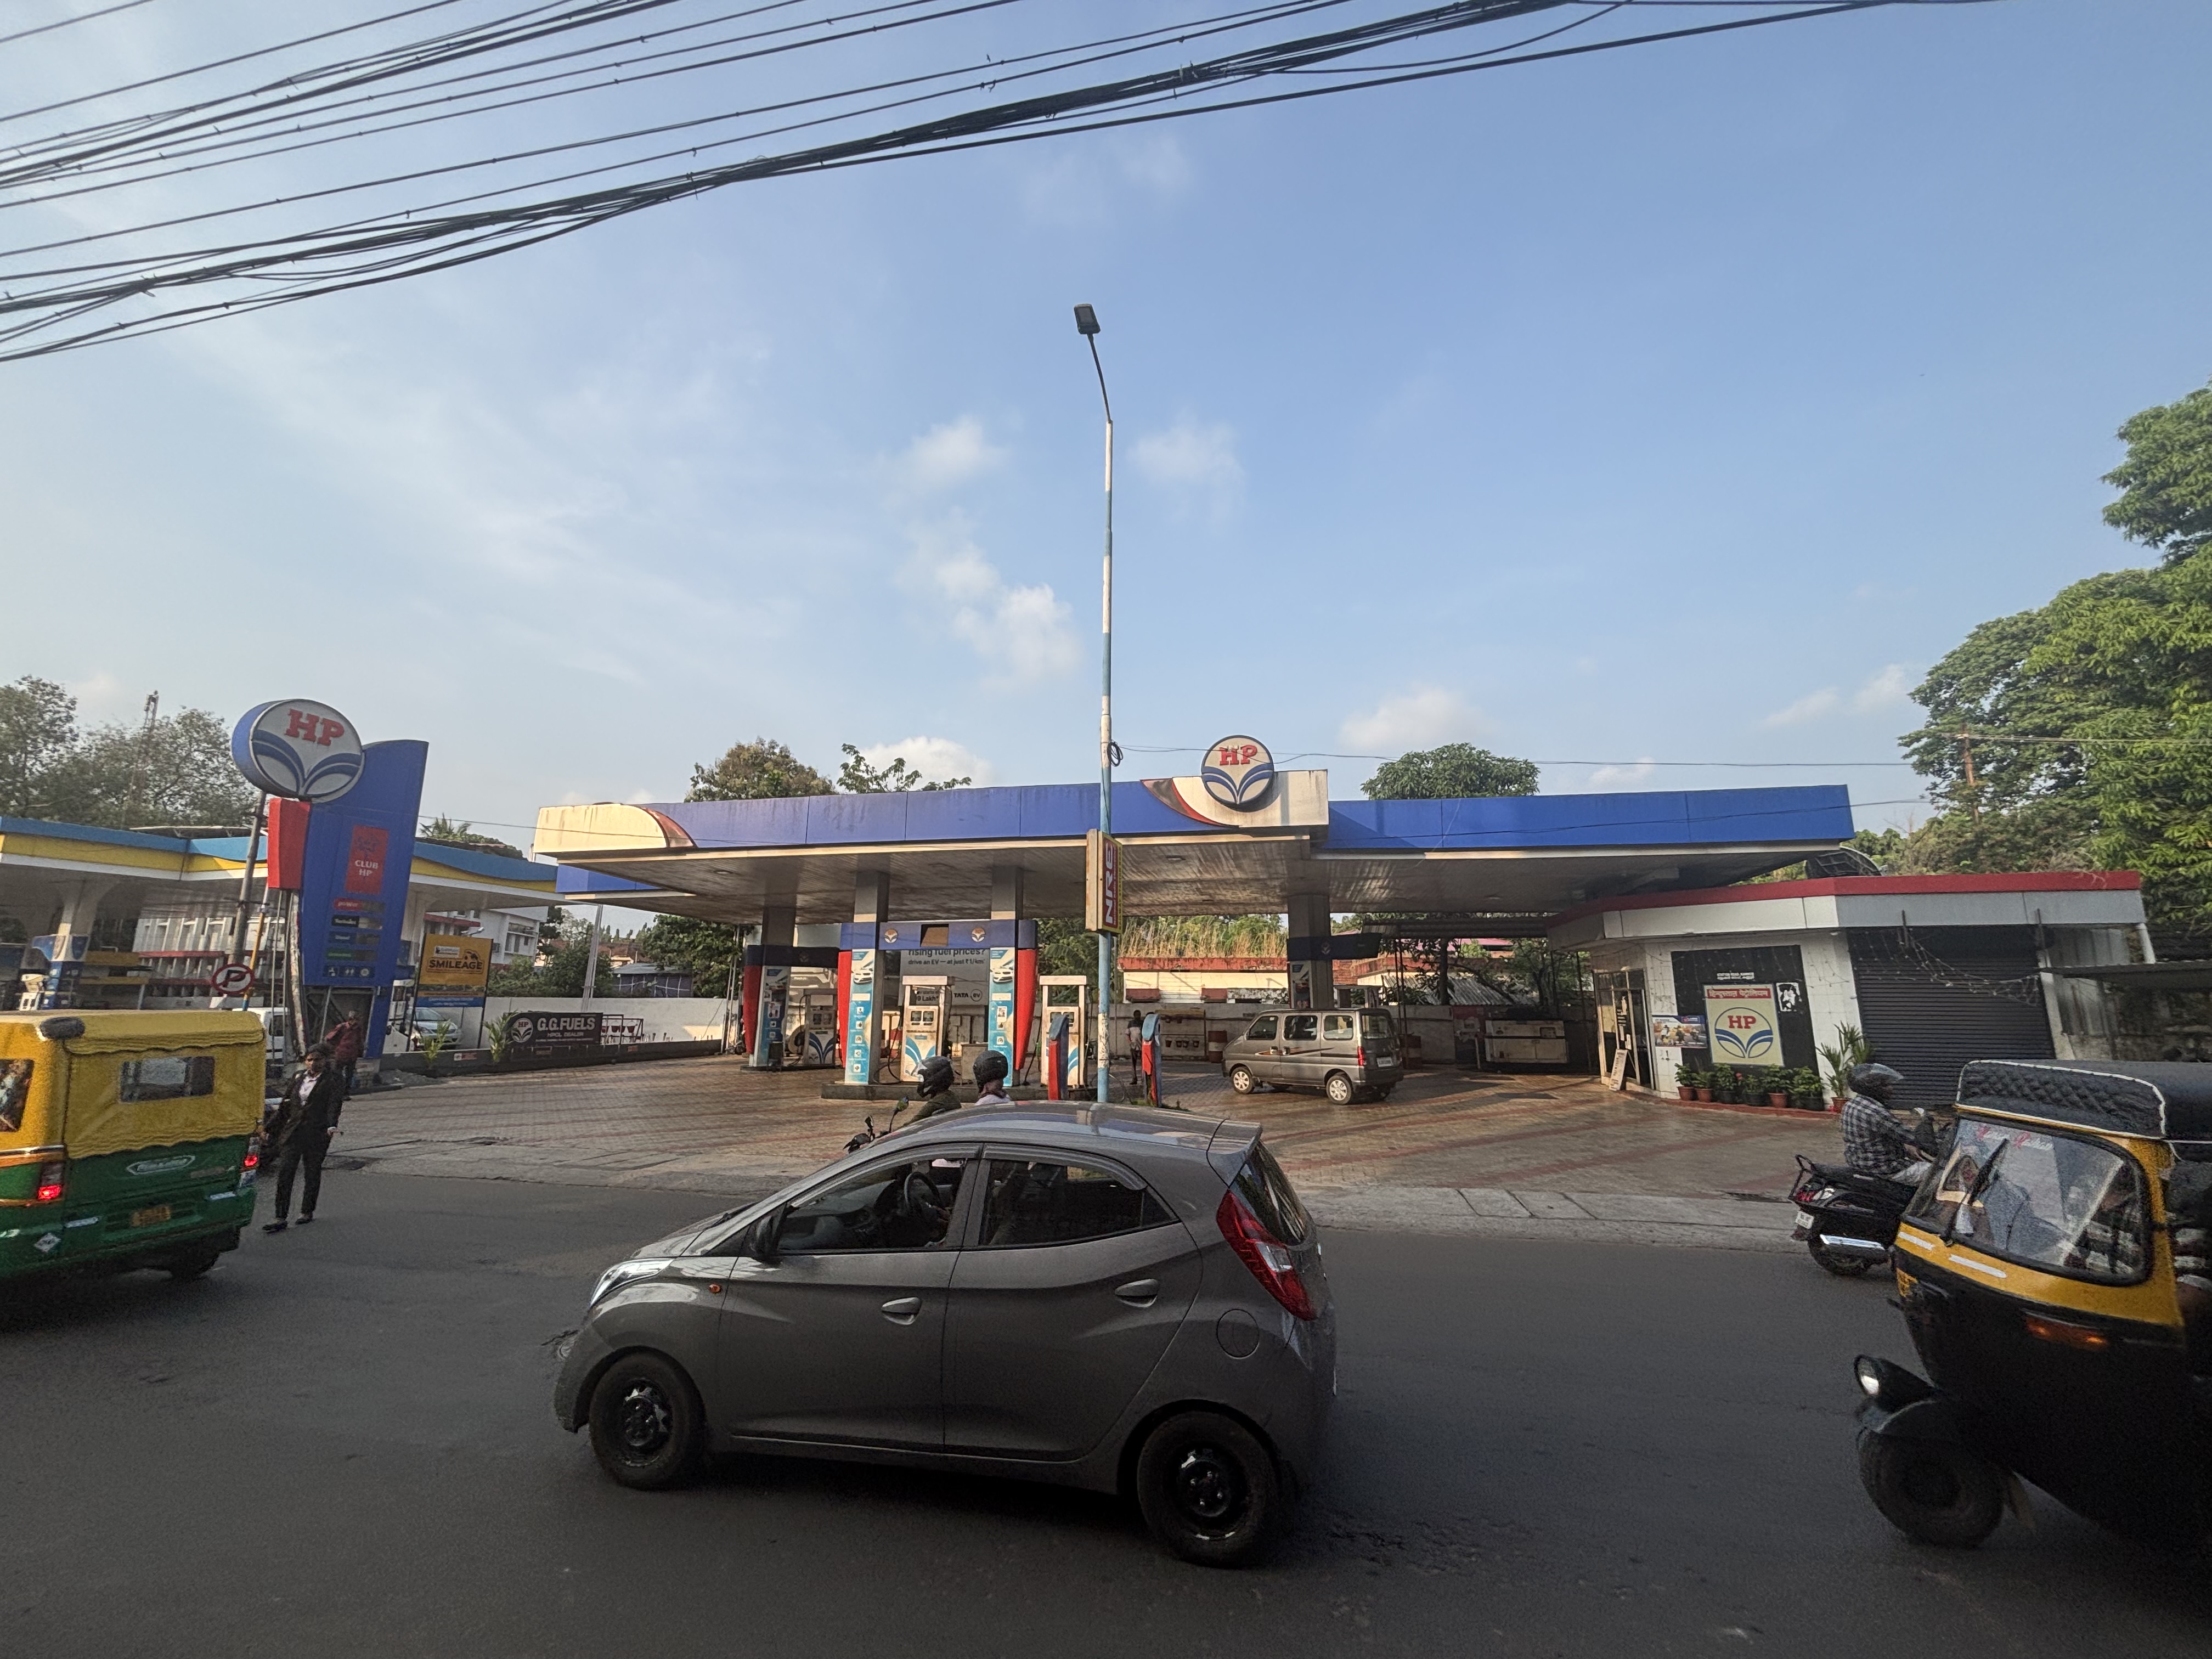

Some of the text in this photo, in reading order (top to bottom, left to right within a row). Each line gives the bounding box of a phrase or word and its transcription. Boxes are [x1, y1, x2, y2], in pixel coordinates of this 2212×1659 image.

[285, 709, 345, 746] HP
[1220, 744, 1257, 766] HP
[355, 860, 379, 870] CLUB
[429, 960, 483, 969] SMILEAGE
[1728, 1015, 1757, 1029] HP
